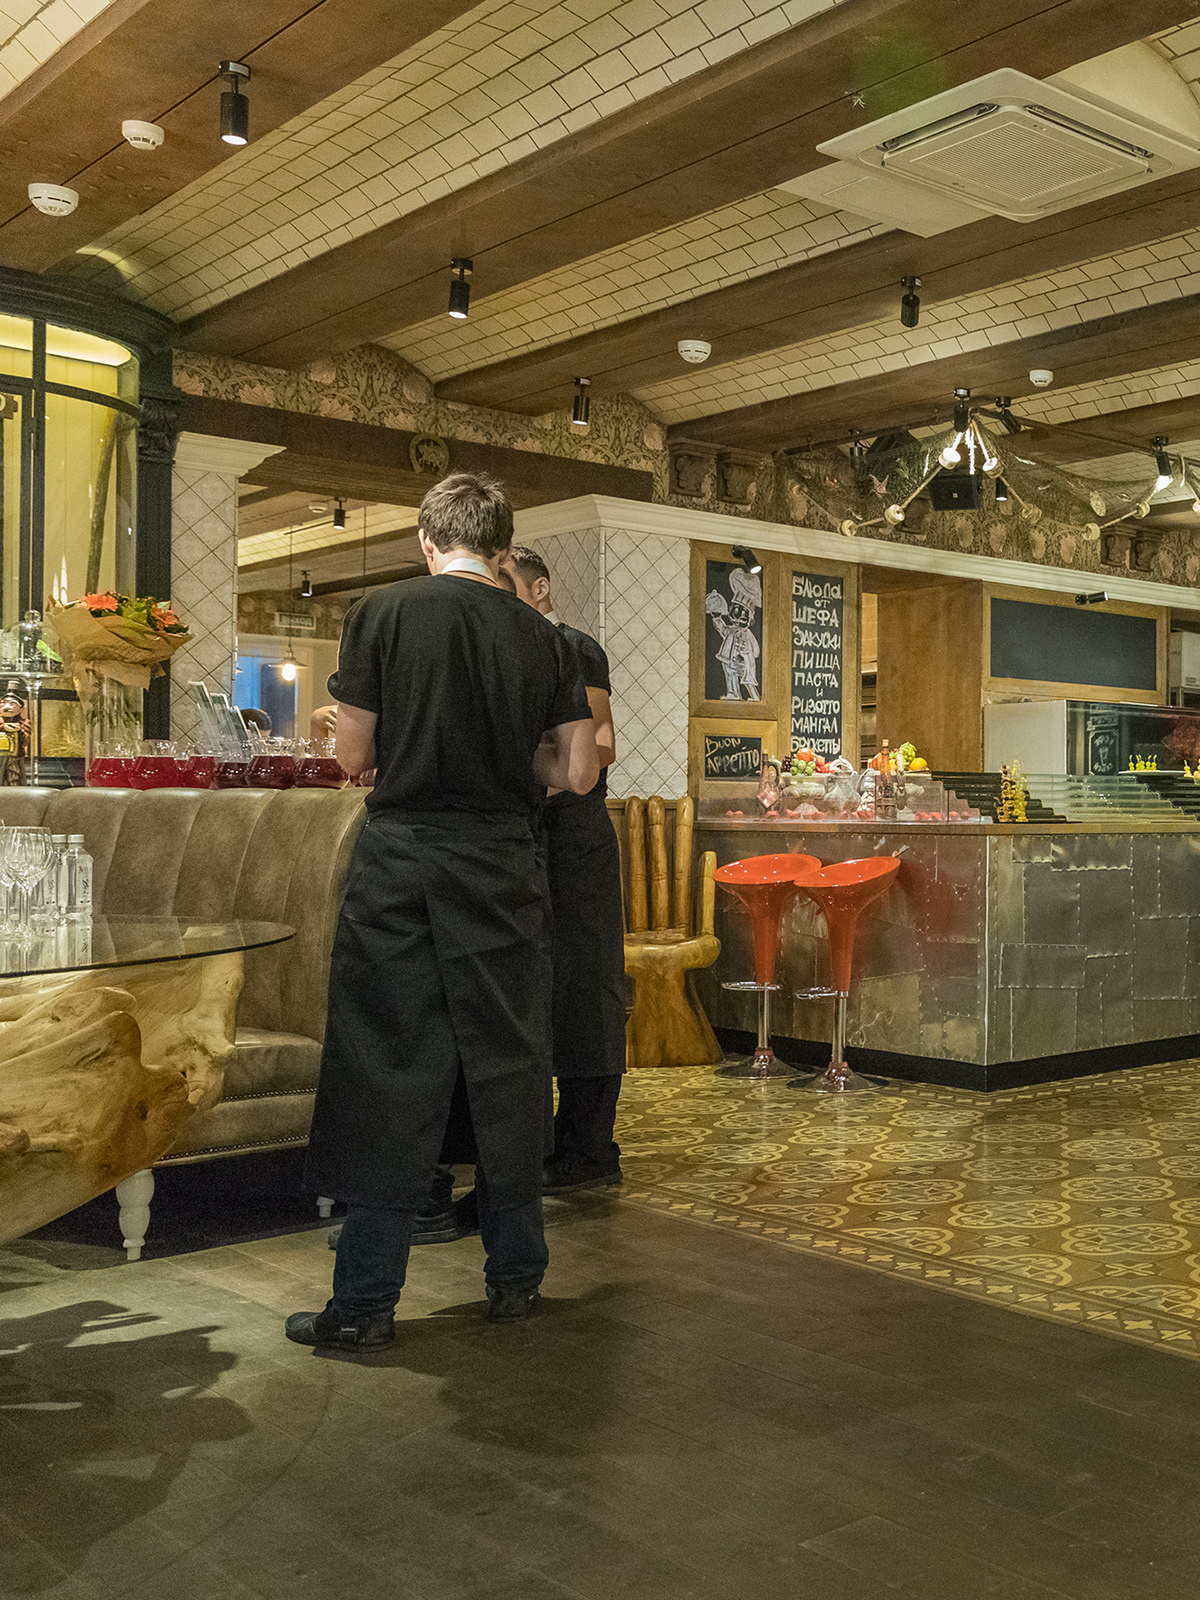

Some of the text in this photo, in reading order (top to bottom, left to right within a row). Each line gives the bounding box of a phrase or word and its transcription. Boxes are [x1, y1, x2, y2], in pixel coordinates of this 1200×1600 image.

[792, 601, 840, 628] ШЕФА
[792, 625, 841, 650] ЗАКУСКИ
[792, 650, 841, 671] ПИЦЦА
[794, 672, 839, 688] ПАСТА
[791, 695, 841, 715] РИЗОТТО
[791, 715, 838, 734] МАНГАЛ
